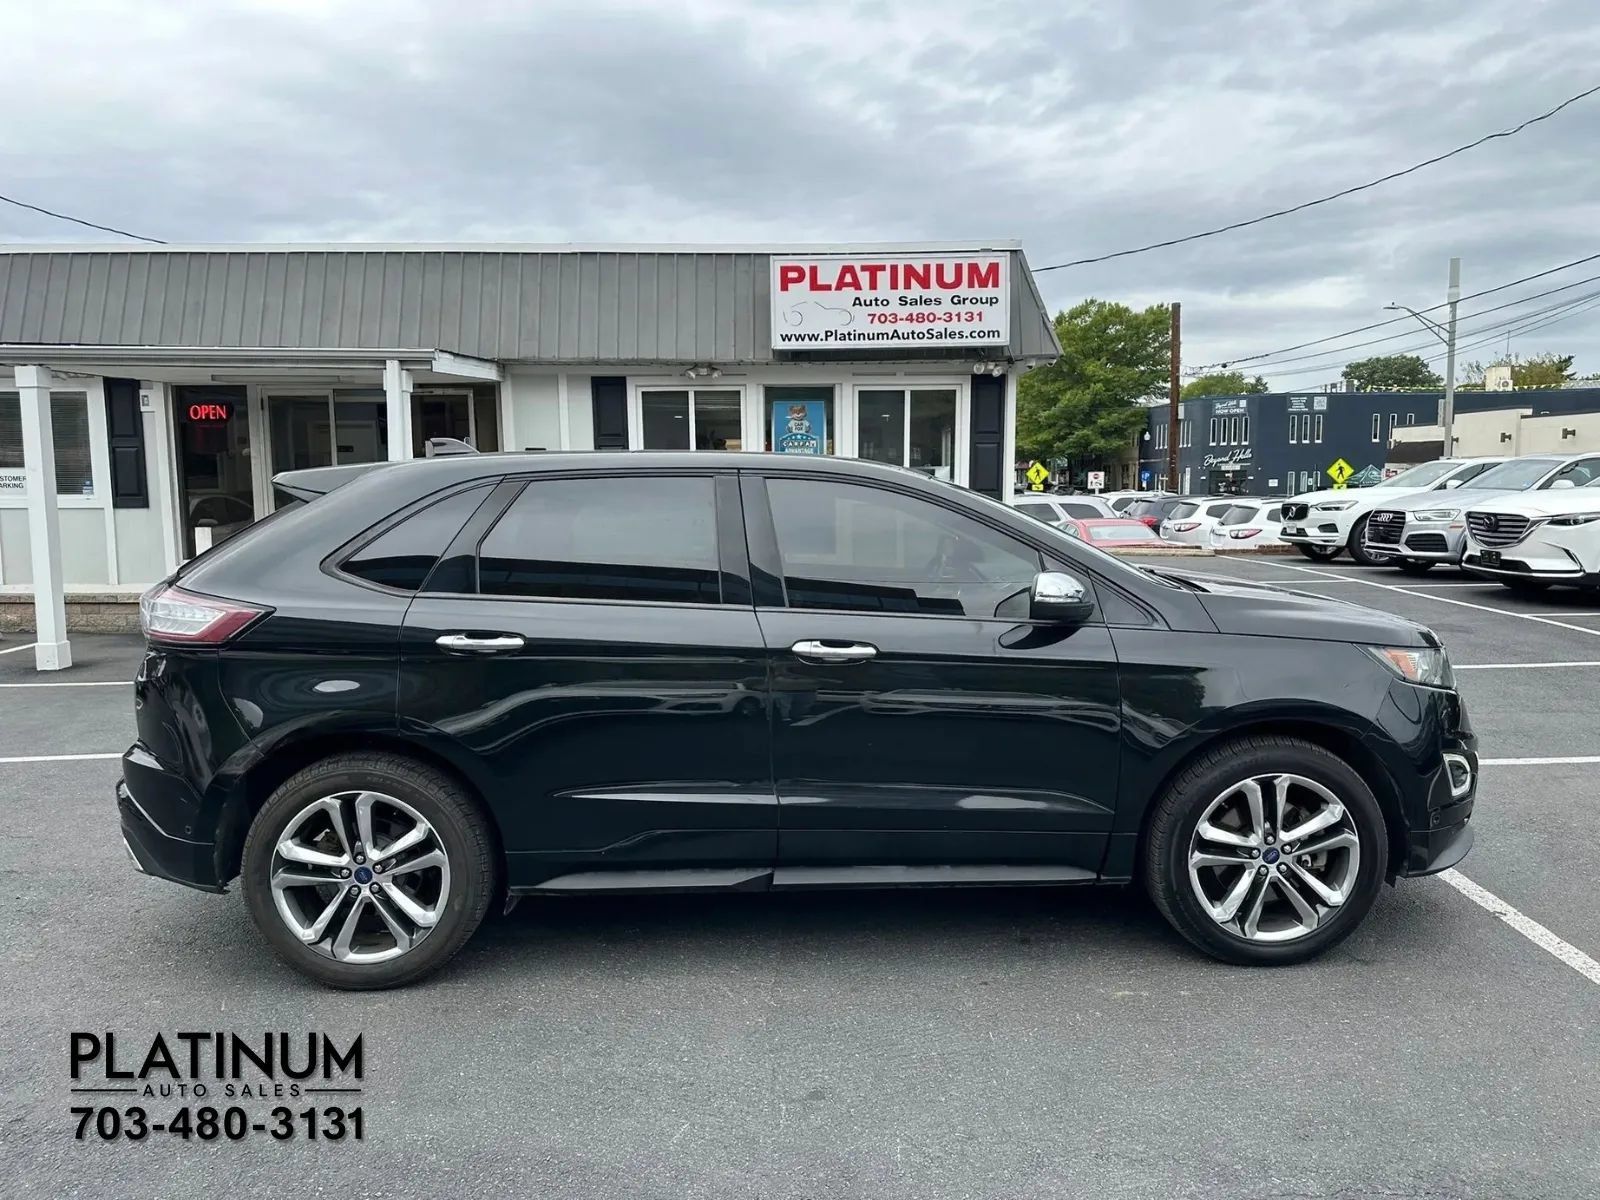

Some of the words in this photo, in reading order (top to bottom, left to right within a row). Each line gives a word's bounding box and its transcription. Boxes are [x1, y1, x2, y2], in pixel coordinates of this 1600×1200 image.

[780, 262, 1000, 292] PLATINUM
[852, 296, 890, 308] Auto
[898, 295, 942, 307] Sales
[950, 295, 999, 307] Group
[867, 311, 983, 325] 703-480-3131
[779, 327, 1000, 343] www.PlatinumAutoSales.com
[189, 404, 227, 420] OPEN
